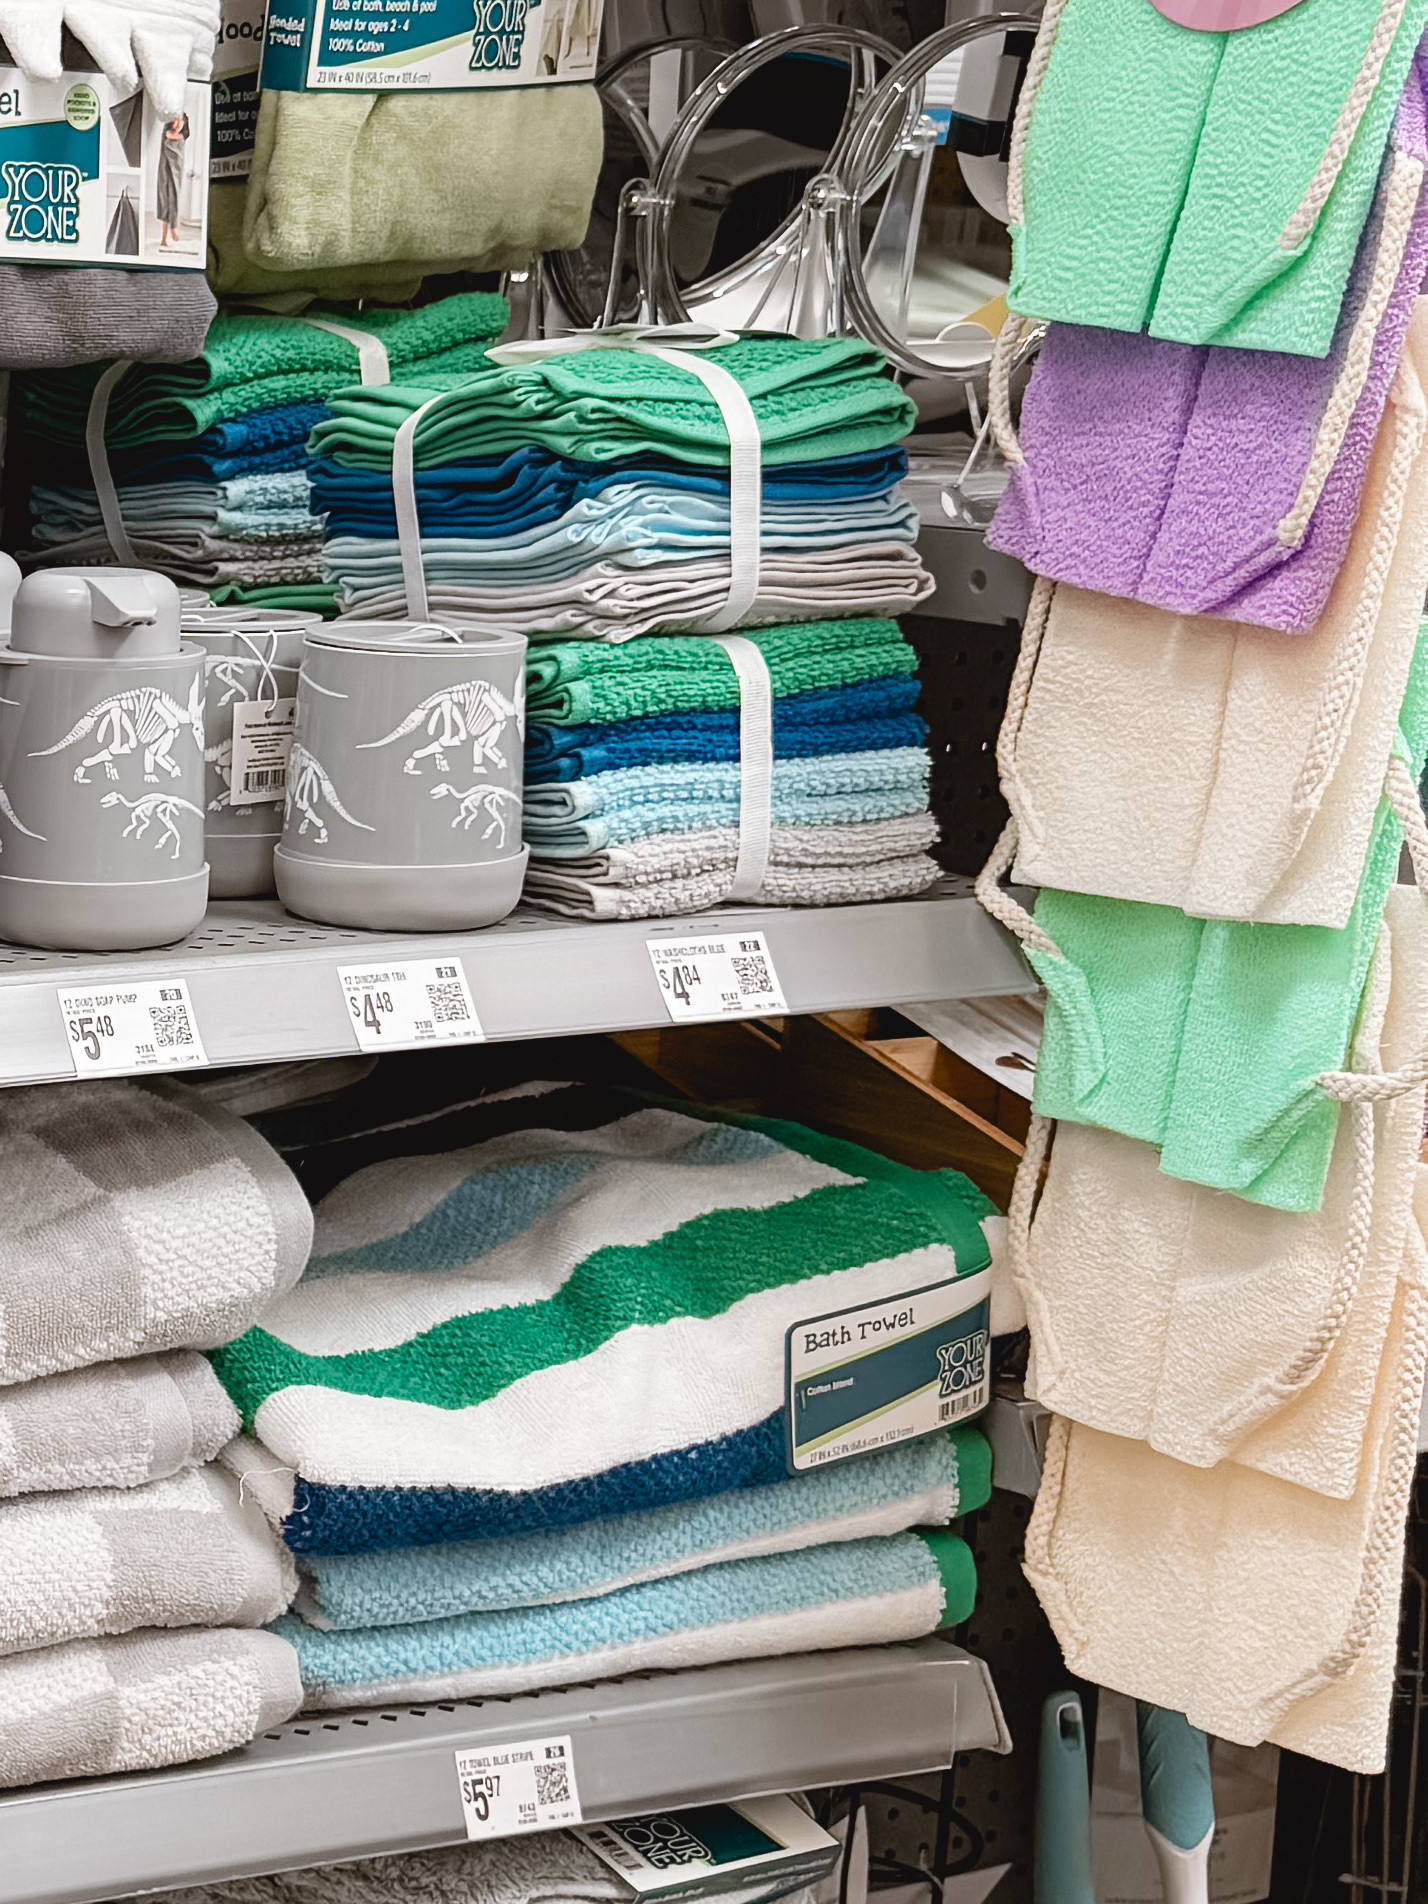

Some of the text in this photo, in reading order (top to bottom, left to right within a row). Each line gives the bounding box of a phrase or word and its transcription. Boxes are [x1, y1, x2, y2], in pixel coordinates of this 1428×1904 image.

[471, 35, 522, 68] ZONE
[8, 167, 77, 203] YOUR
[10, 205, 76, 239] ZONE
[805, 1308, 916, 1354] Bath Towel
[939, 1336, 985, 1370] YOUR
[941, 1362, 983, 1395] ZONE
